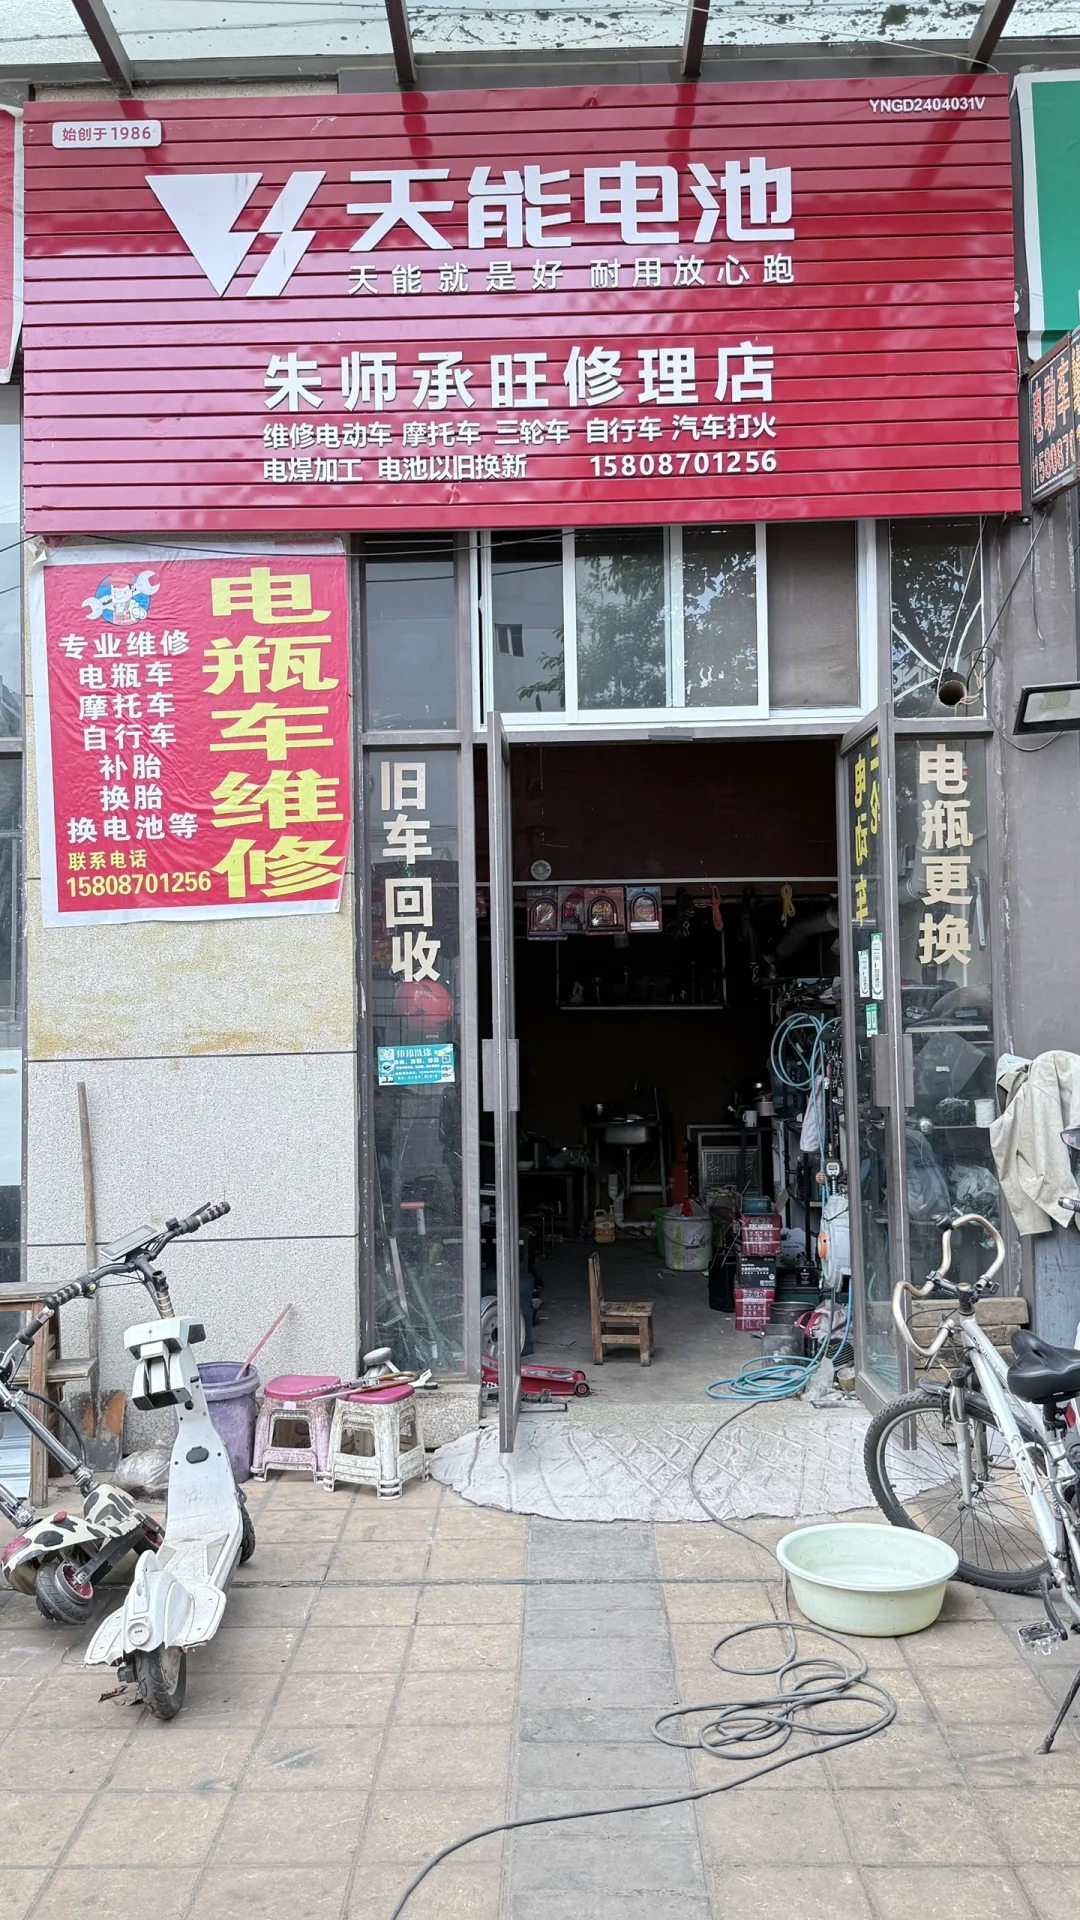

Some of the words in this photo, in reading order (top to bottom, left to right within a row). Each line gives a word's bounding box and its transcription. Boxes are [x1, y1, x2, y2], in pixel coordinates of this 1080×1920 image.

[869, 97, 985, 112] YNGD2404031V
[347, 157, 796, 252] 天能电池
[347, 259, 564, 295] 天能就是好
[589, 252, 795, 288] 耐用放心跑
[264, 341, 775, 412] 朱师承旺修理店
[263, 422, 393, 449] 维修电动车
[402, 420, 481, 447] 摩托车
[494, 418, 571, 445] 三轮车
[586, 416, 663, 444] 自行车
[671, 412, 777, 441] 汽车打火
[263, 457, 363, 482] 电焊加工
[378, 453, 527, 481] 电池以旧换新
[590, 449, 777, 477] 15808701256
[58, 629, 190, 660] 专业维修
[79, 661, 174, 690] 电瓶车
[78, 691, 175, 721] 摩托车
[83, 723, 177, 752] 自行车
[203, 567, 345, 898] 电瓶车维修
[98, 753, 162, 781] 补胎
[99, 783, 163, 812] 换胎
[67, 812, 198, 845] 换电池等
[68, 849, 147, 871] 联系电话
[919, 743, 973, 965] 电瓶更换
[66, 870, 211, 898] 15808701256
[380, 761, 441, 983] 旧车回收
